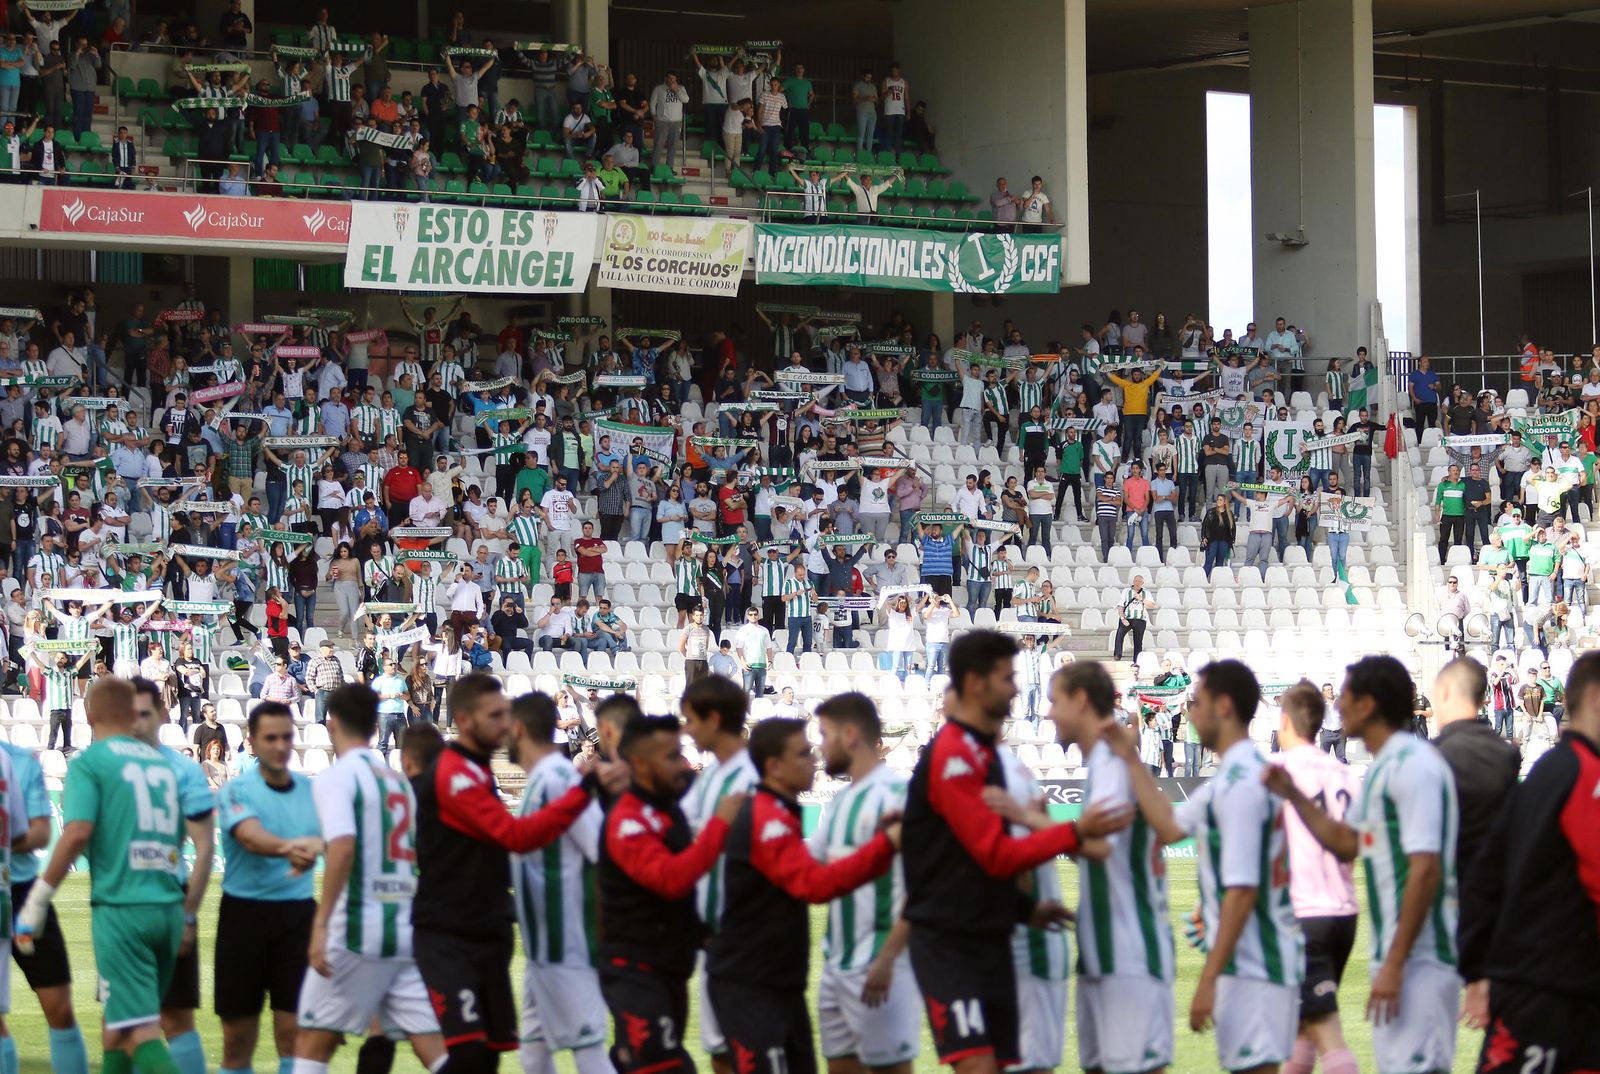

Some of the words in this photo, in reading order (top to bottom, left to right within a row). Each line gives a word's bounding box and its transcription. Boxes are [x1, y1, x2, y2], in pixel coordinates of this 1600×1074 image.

[87, 205, 145, 226] CajaSur
[208, 211, 265, 230] CajaSur
[418, 207, 489, 244] ESTO
[500, 210, 534, 247] ES
[361, 244, 397, 283] EL
[408, 241, 574, 287] ARCÁNGEL
[656, 249, 713, 260] CORDOBESISTA
[757, 234, 946, 280] INCONDICIONALES
[1021, 244, 1059, 282] CCF
[600, 271, 671, 285] VILLAVICIOSA
[673, 276, 686, 287] DE
[122, 763, 178, 835] 13
[951, 998, 985, 1038] 14
